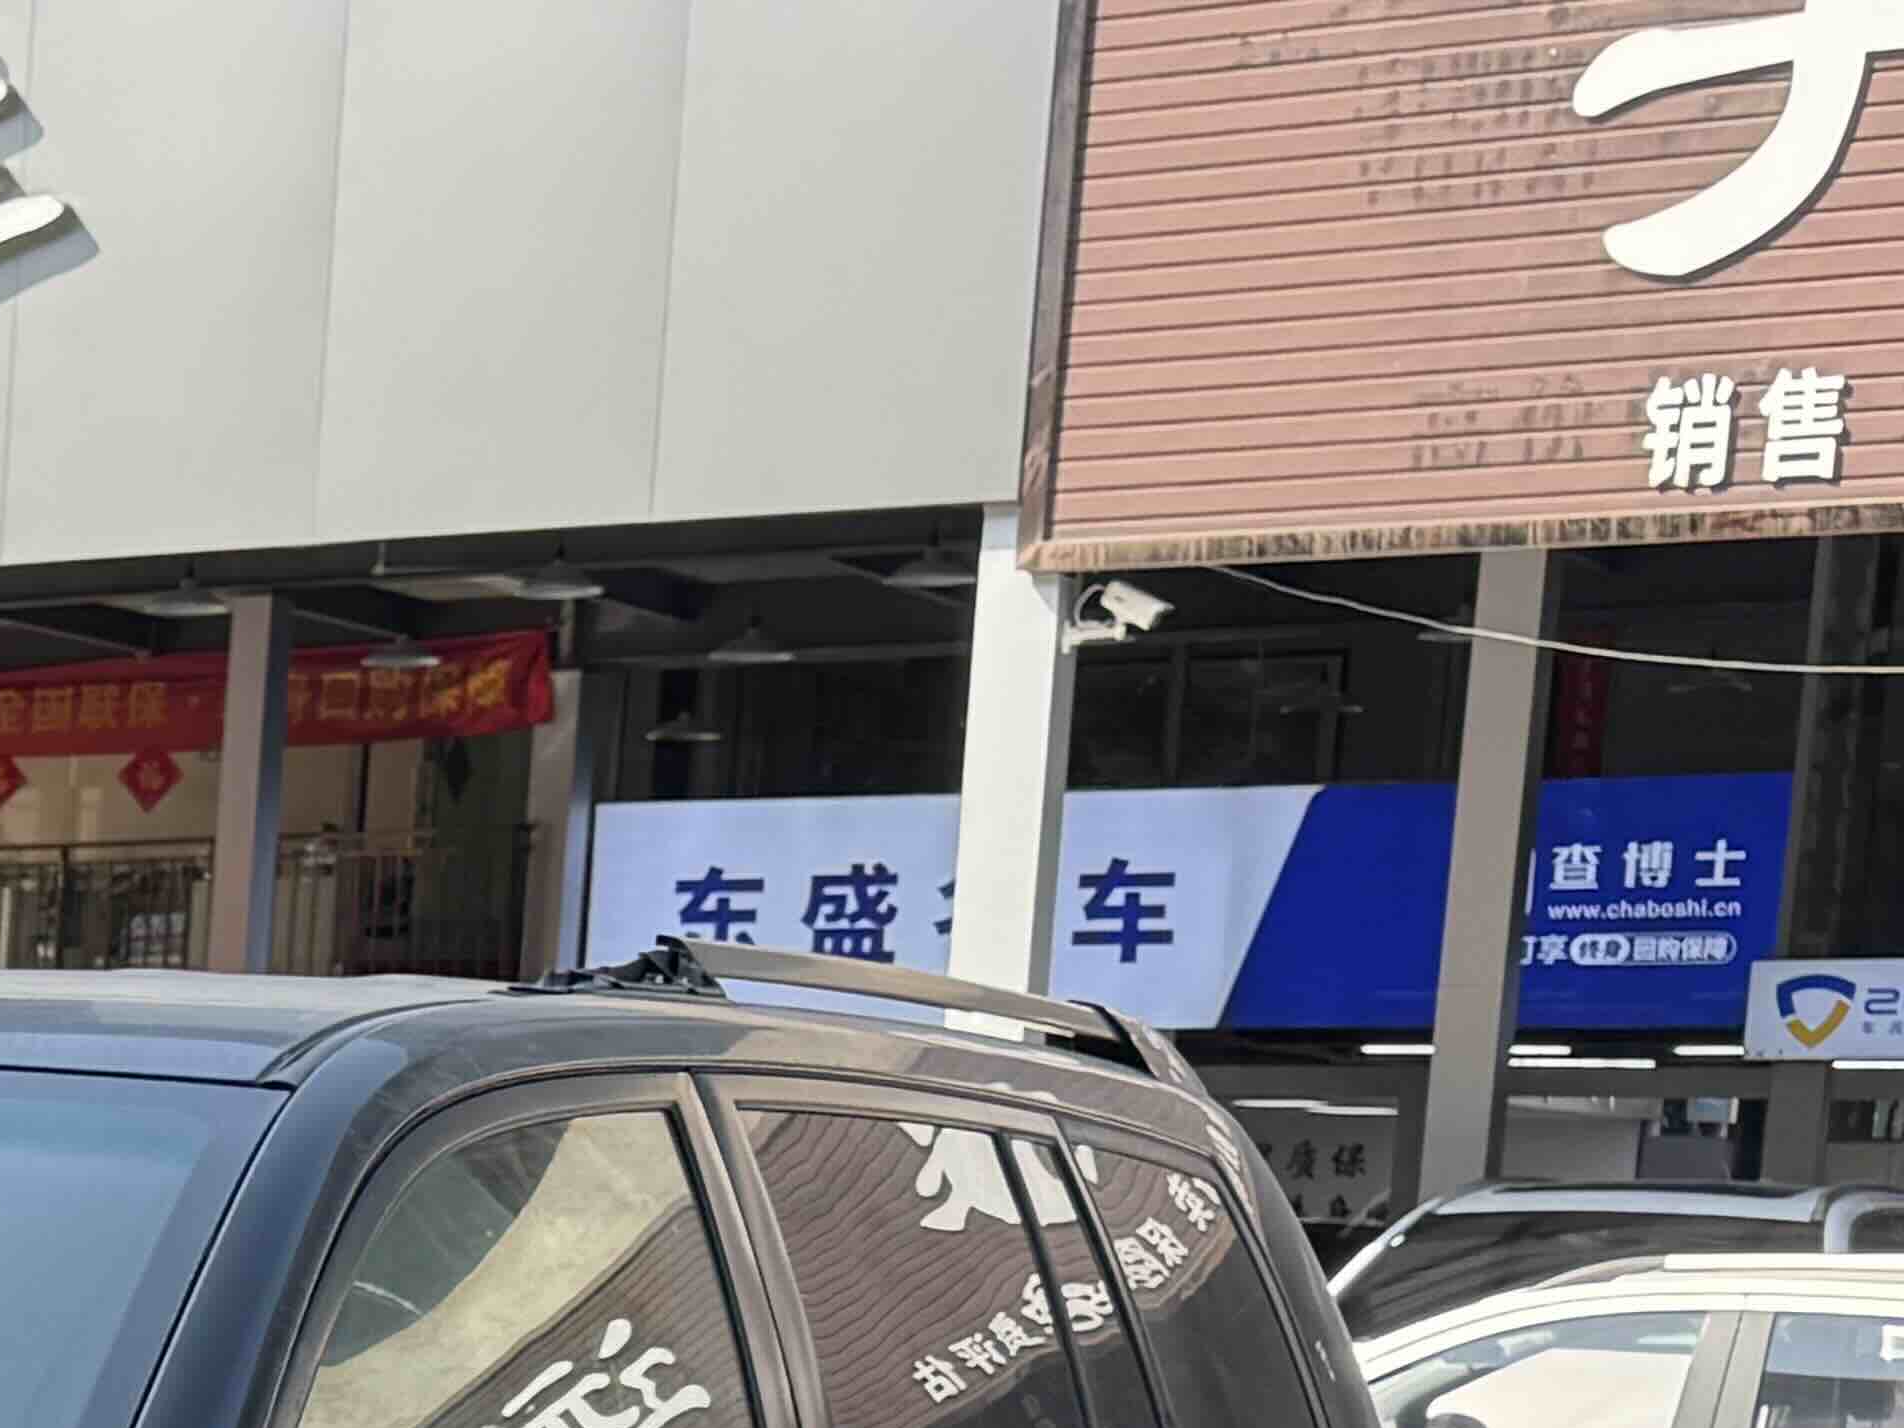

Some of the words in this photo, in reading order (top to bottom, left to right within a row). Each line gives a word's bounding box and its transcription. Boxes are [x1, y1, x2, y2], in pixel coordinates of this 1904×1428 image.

[1642, 367, 1846, 490] 销售
[1549, 839, 1746, 890] 查博士
[676, 858, 1176, 963] 东盛车
[1547, 897, 1741, 921] www.chaboshi.cn
